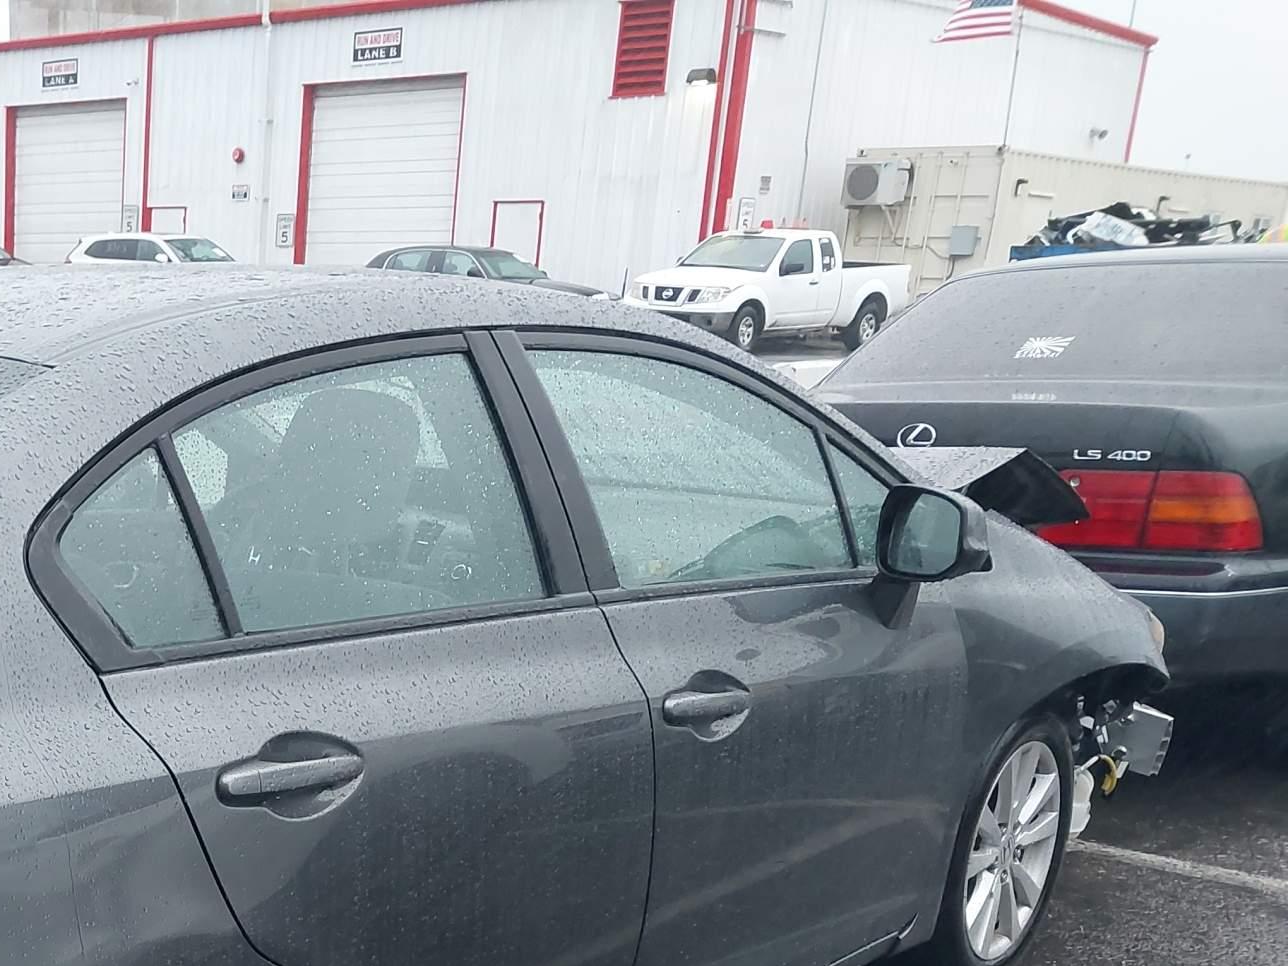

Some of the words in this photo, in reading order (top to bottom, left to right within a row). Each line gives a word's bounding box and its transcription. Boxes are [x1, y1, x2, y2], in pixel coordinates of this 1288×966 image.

[370, 34, 381, 45] AND
[382, 32, 400, 45] DRIVE
[357, 48, 386, 60] LANE
[389, 46, 398, 57] B
[44, 75, 66, 86] LANE
[126, 221, 133, 232] 5
[281, 231, 289, 243] 5
[1073, 449, 1102, 460] LS
[1107, 450, 1152, 461] 400
